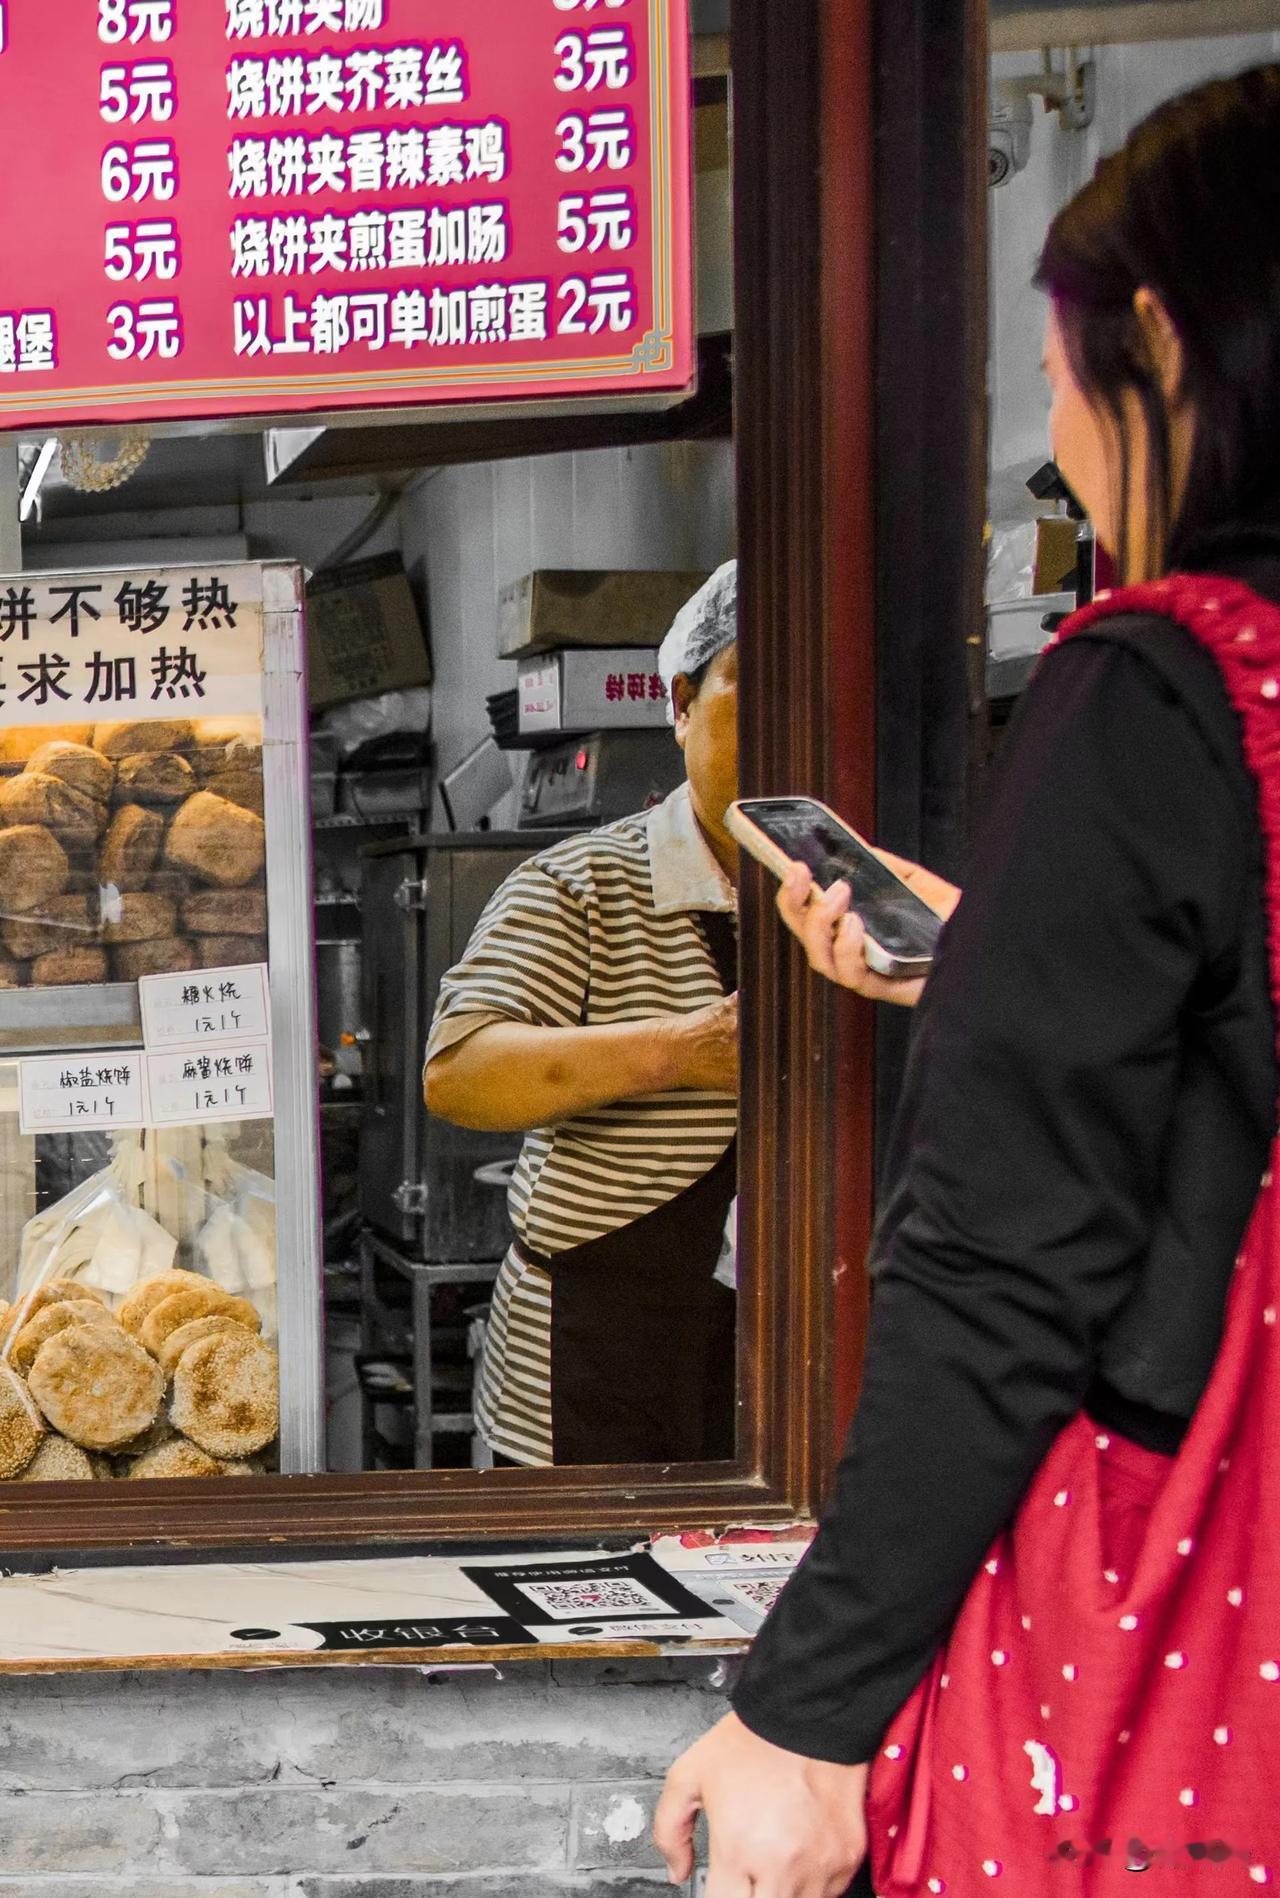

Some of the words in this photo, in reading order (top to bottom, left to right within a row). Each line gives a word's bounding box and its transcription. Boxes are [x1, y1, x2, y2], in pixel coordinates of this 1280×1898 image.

[98, 0, 171, 44] 8元
[100, 65, 172, 123] 5元
[226, 47, 463, 119] 烧饼夹芥菜丝
[554, 32, 628, 91] 3元
[102, 144, 174, 202] 6元
[228, 123, 504, 198] 烧饼夹香辣素鸡
[556, 113, 629, 171] 3元
[105, 224, 176, 281] 5元
[230, 206, 504, 277] 烧饼夹煎蛋加肠
[558, 194, 630, 252] 5元
[107, 303, 178, 360] 3元
[234, 282, 546, 357] 以上都可单加煎蛋
[558, 275, 630, 334] 2元
[0, 646, 207, 707] 求加热
[339, 1624, 500, 1642] 收银台
